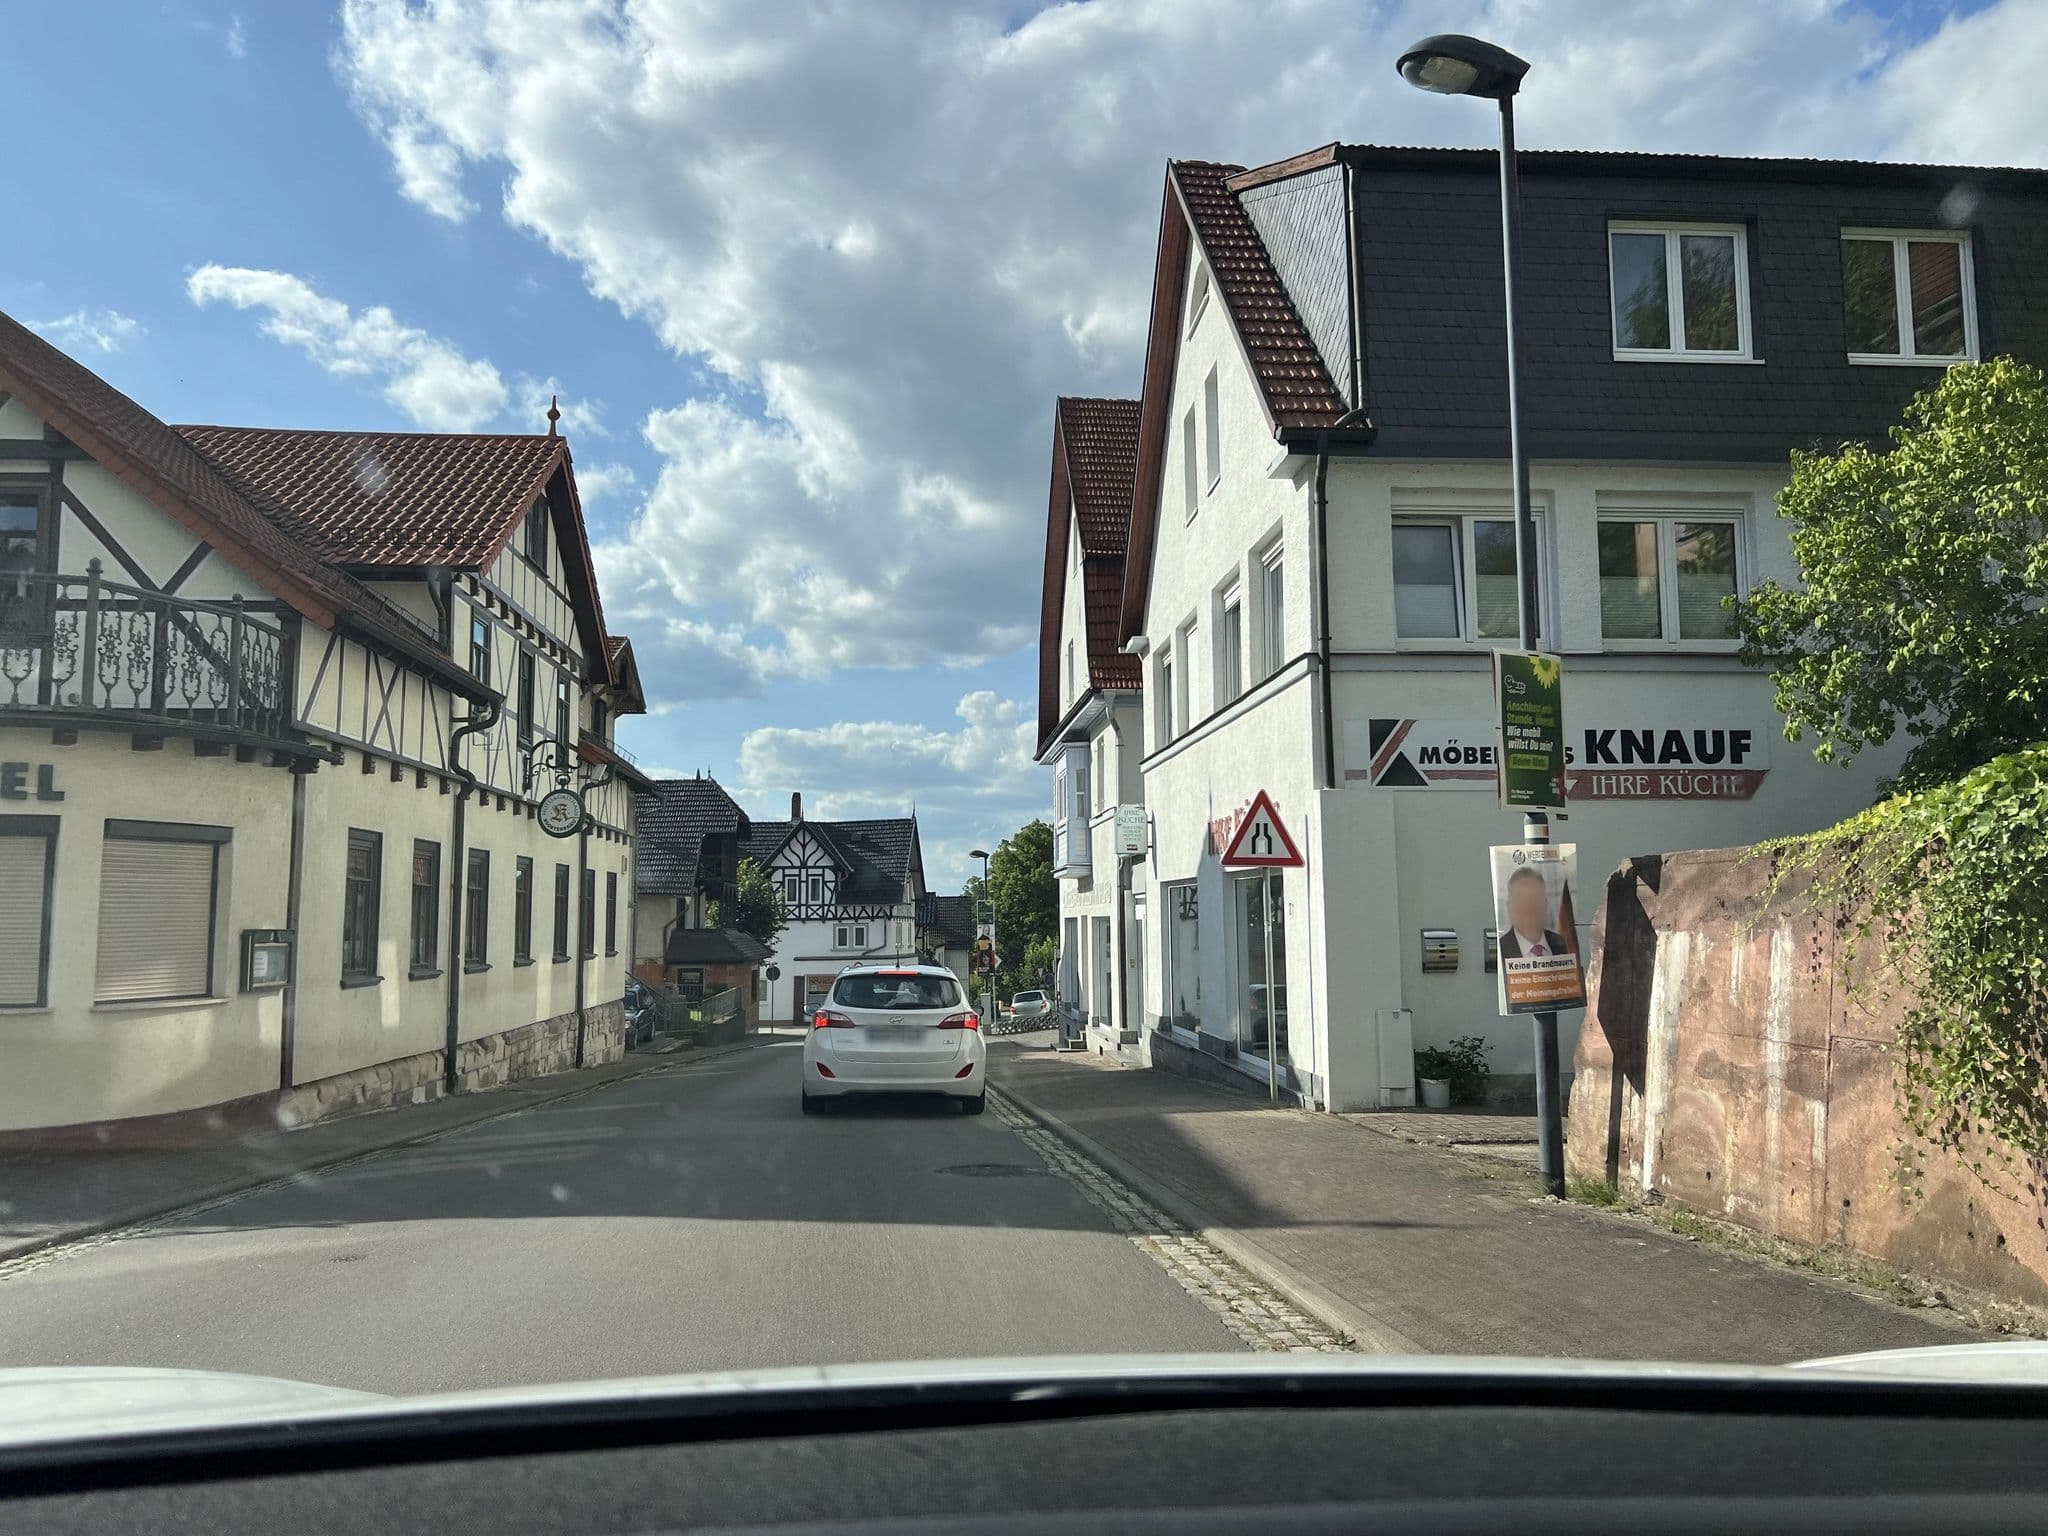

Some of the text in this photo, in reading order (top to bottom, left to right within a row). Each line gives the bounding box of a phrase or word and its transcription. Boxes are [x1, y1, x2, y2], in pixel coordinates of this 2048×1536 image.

[1507, 726, 1541, 738] Wie mobil
[1508, 738, 1528, 749] willst
[1530, 739, 1539, 750] Du
[1584, 729, 1752, 765] KNAUF
[1592, 770, 1744, 796] IHRE KÜCHE
[1508, 962, 1530, 970] Keine
